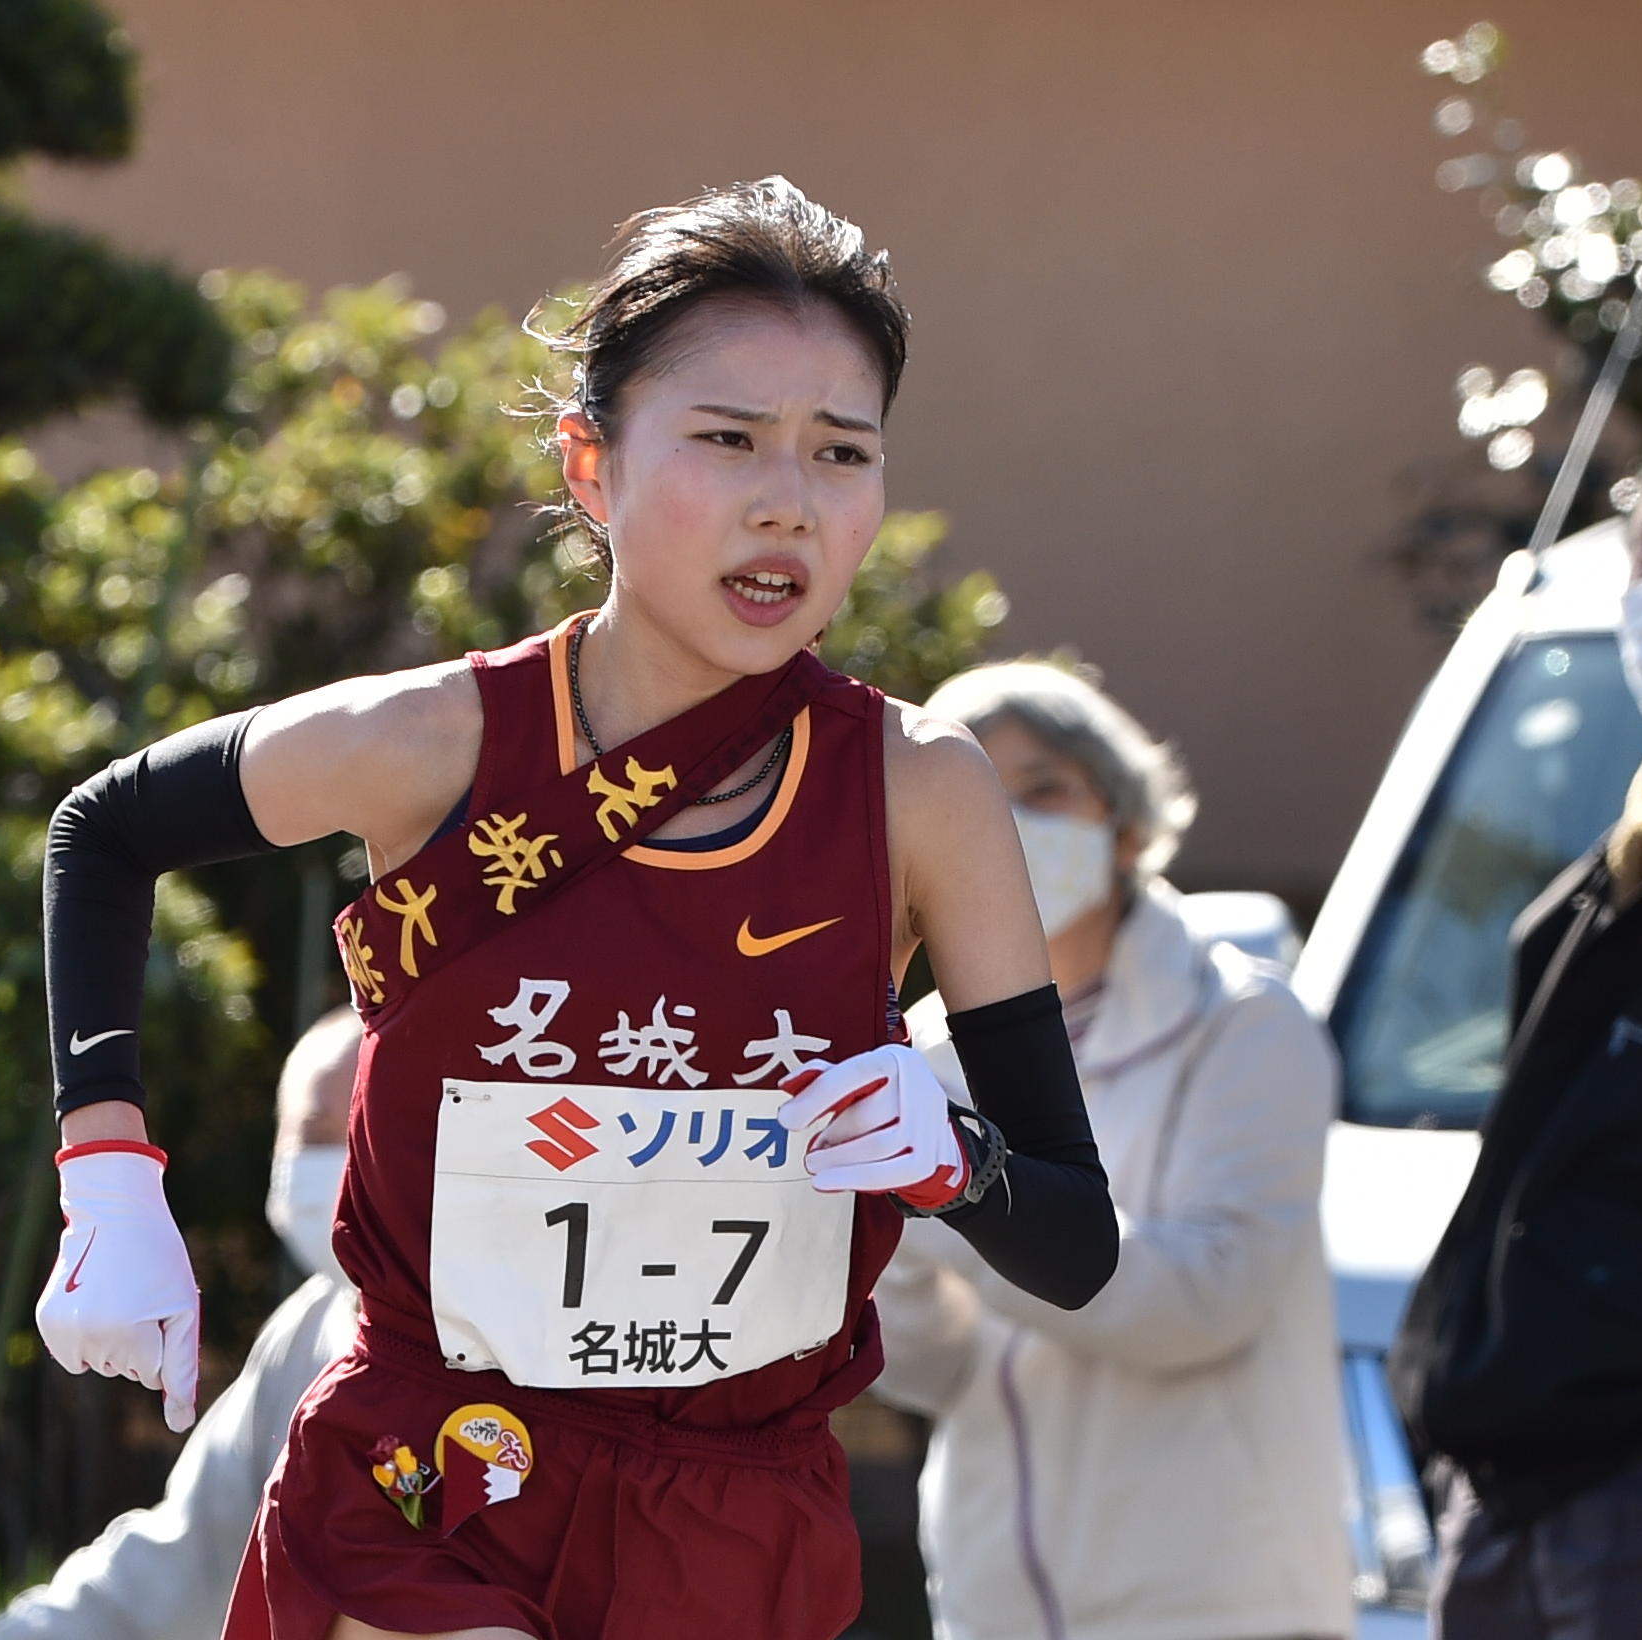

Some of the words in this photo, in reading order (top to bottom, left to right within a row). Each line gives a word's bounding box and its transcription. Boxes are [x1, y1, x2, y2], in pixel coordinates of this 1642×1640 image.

[475, 977, 832, 1088] 名城大
[617, 1109, 789, 1168] ソリオ
[568, 1319, 732, 1375] 名城大
